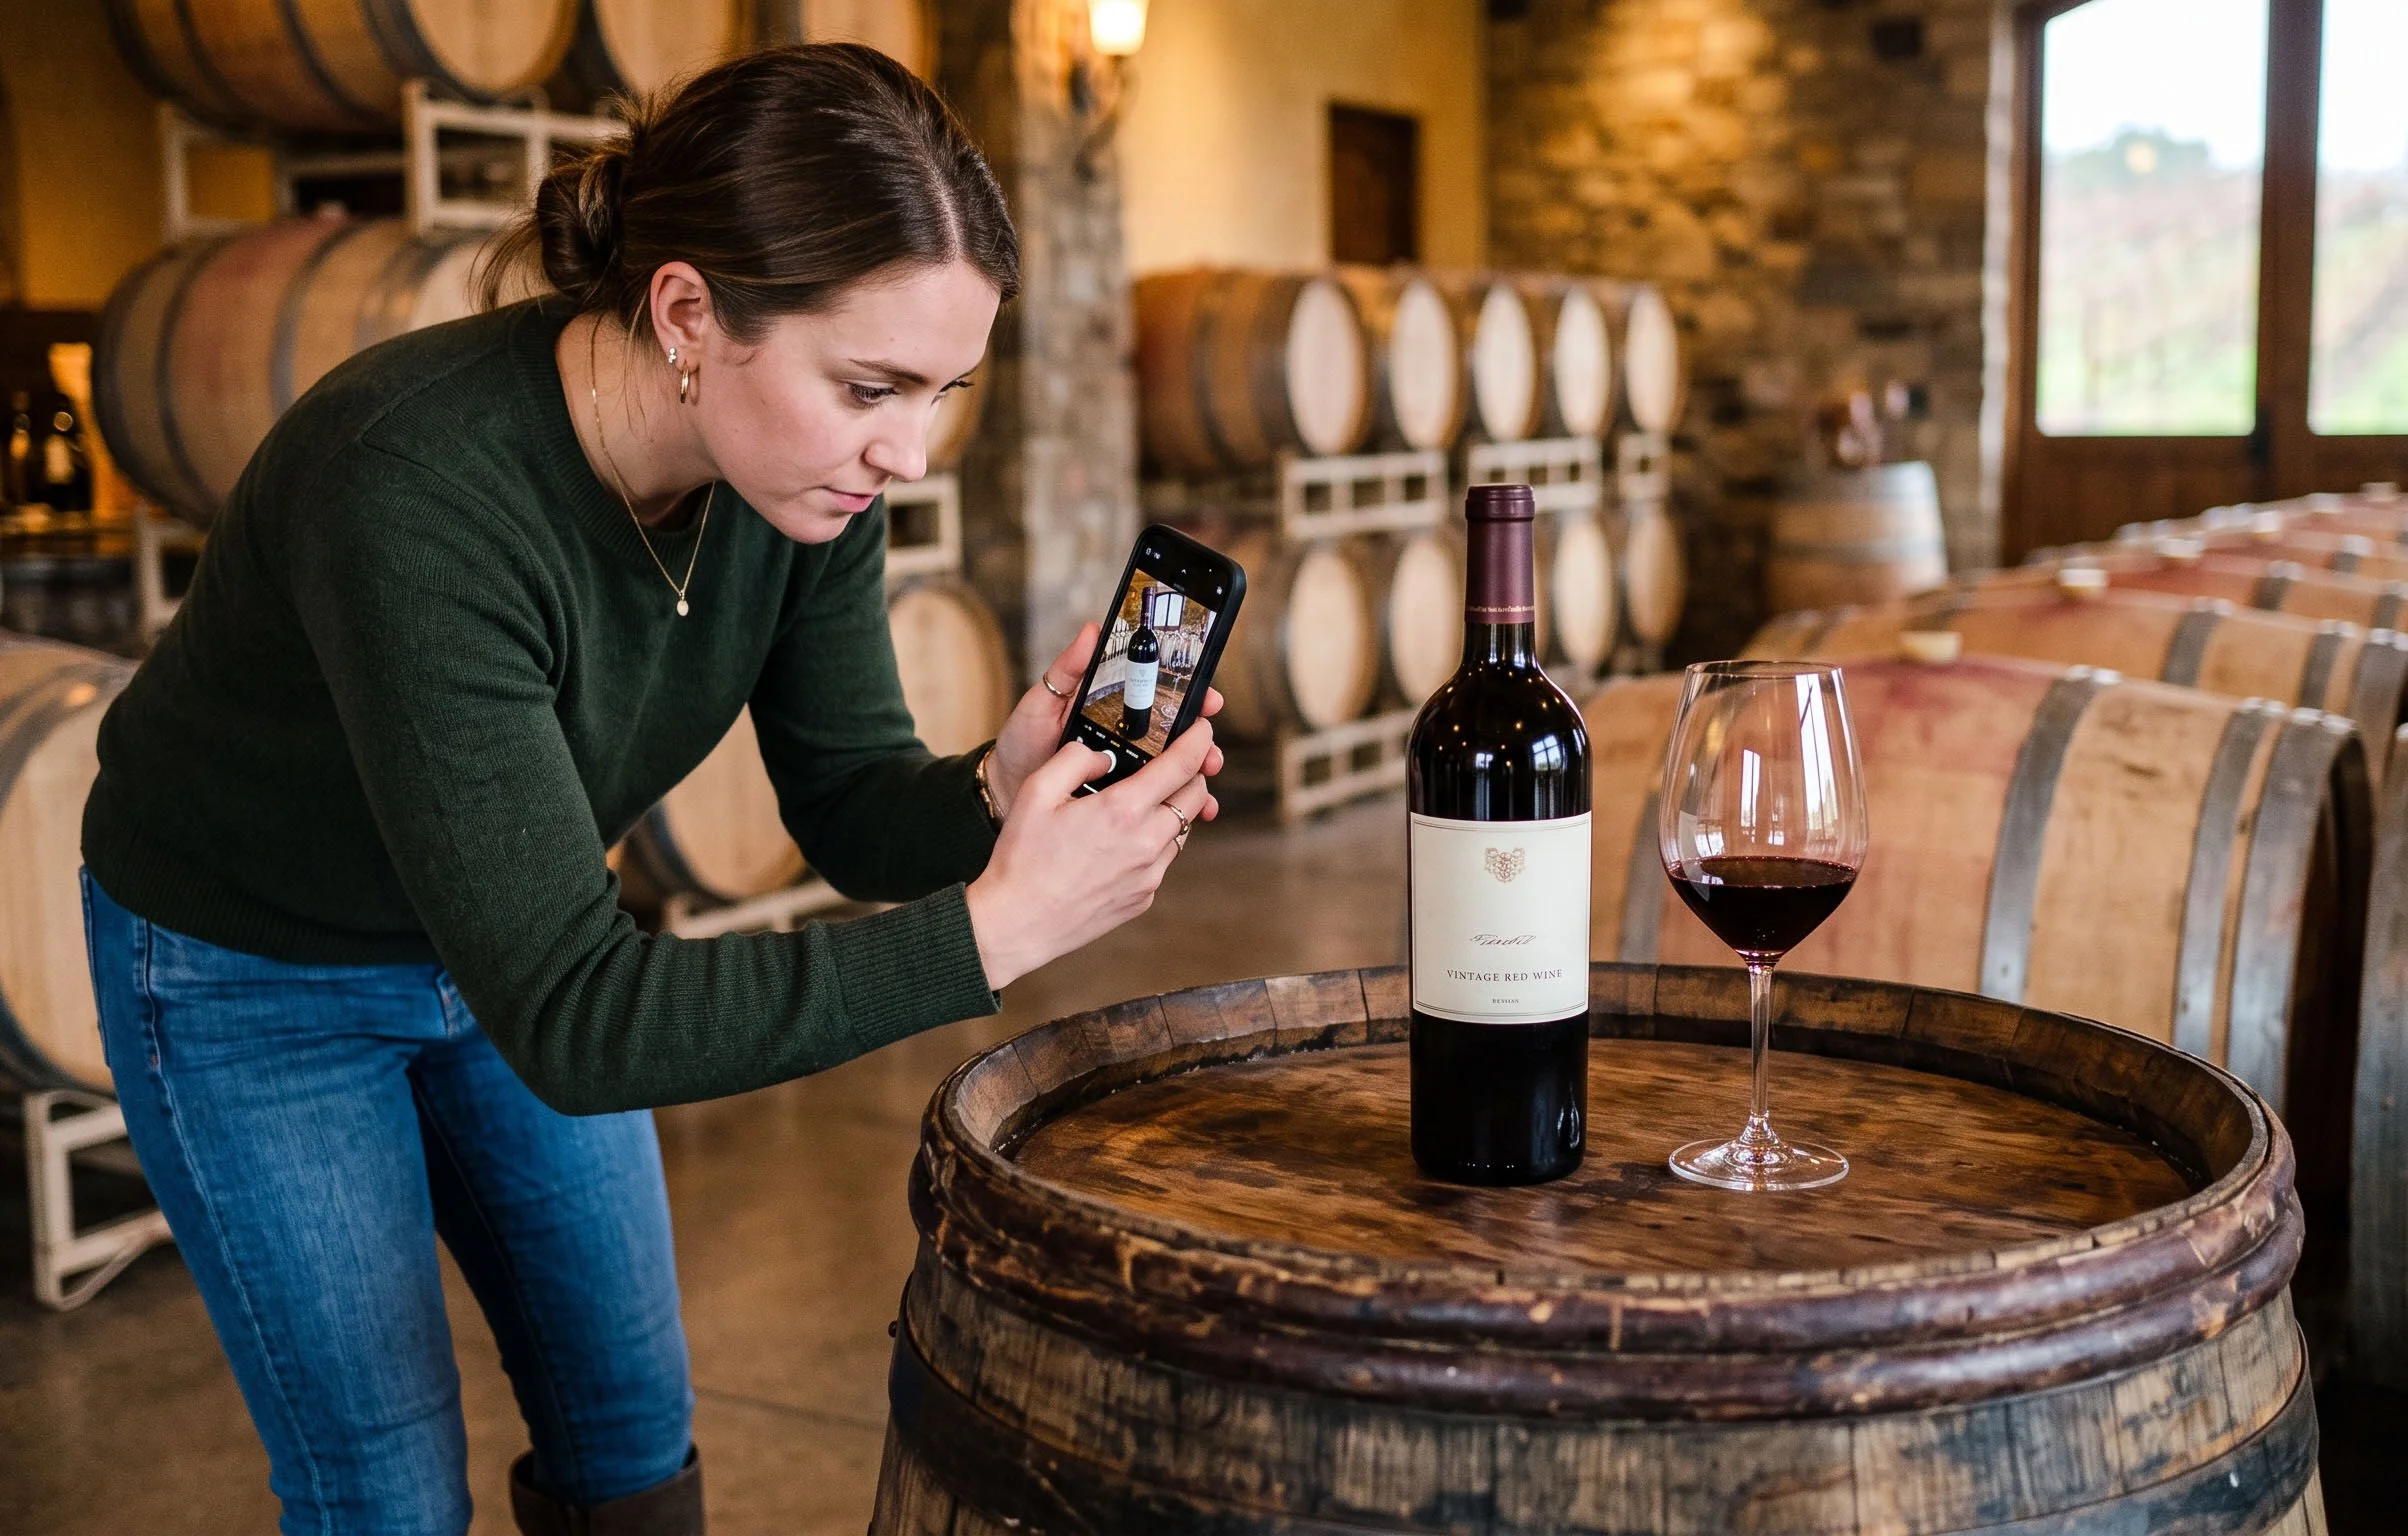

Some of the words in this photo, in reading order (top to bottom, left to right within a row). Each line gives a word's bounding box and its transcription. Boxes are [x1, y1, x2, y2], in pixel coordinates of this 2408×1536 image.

[1447, 969, 1500, 982] VINTAGE
[1504, 972, 1528, 982] RED
[1532, 969, 1563, 980] WINE
